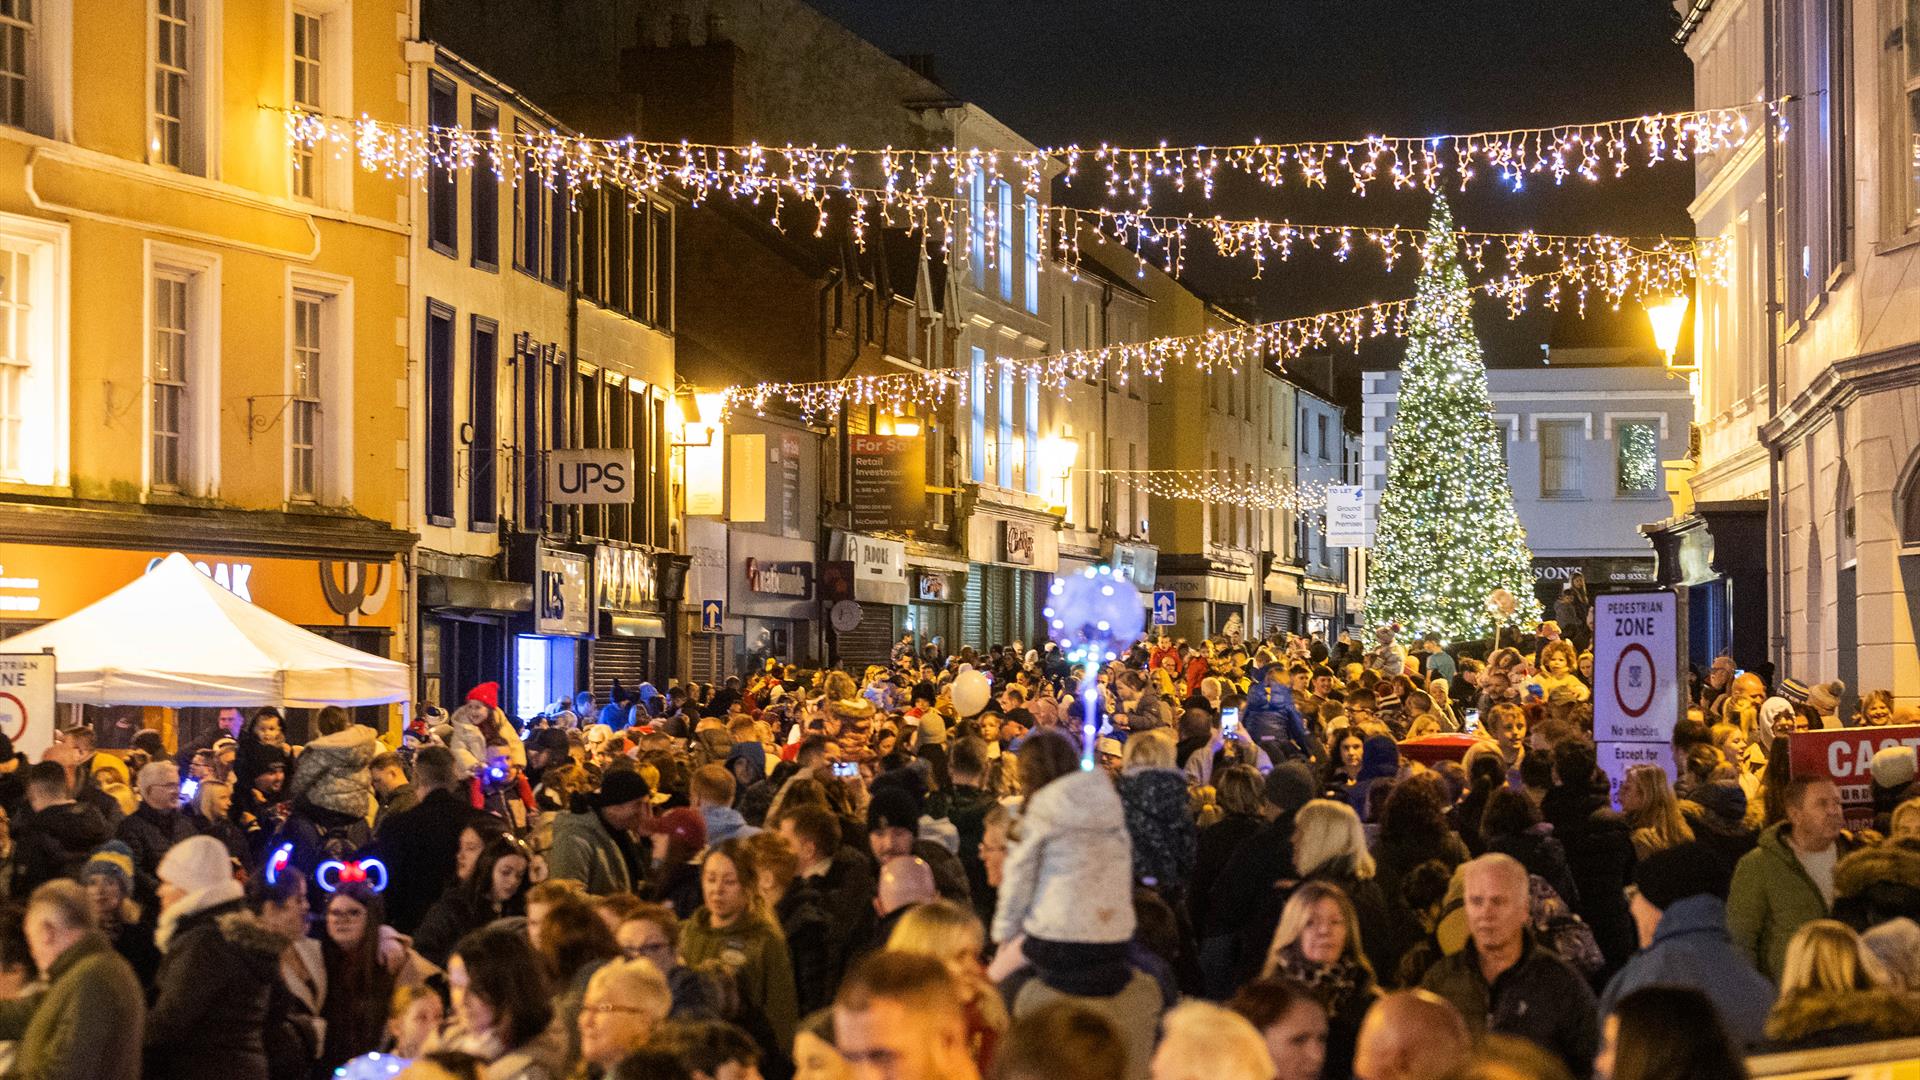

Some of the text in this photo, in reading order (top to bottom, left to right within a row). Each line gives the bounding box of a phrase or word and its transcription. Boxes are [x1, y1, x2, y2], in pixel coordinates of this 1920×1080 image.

[856, 438, 883, 451] For
[855, 457, 883, 466] Retail
[558, 462, 625, 494] UPS
[855, 468, 905, 476] Investmen
[1607, 602, 1663, 614] PEDESTRIAN
[1615, 617, 1655, 636] ZONE
[2, 673, 26, 686] NE
[1611, 724, 1659, 737] No vehicles
[1615, 748, 1659, 761] Except for
[1827, 738, 1920, 777] CAT
